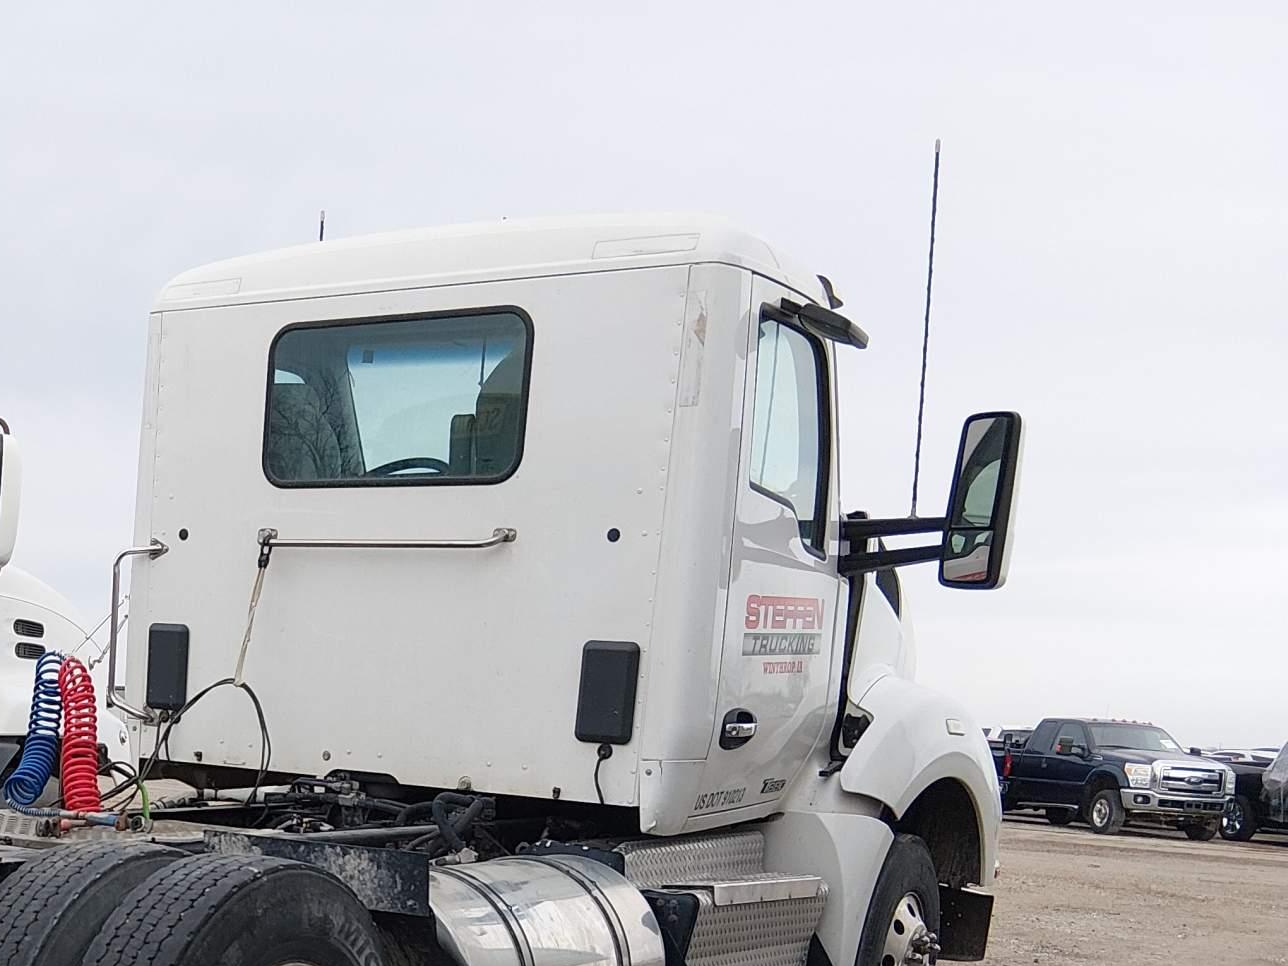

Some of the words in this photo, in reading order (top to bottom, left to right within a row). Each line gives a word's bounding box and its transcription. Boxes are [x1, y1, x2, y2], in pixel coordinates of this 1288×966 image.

[745, 594, 825, 630] STEFFEN
[752, 635, 816, 654] TRUCKING
[694, 793, 708, 811] US
[706, 790, 725, 808] DOT
